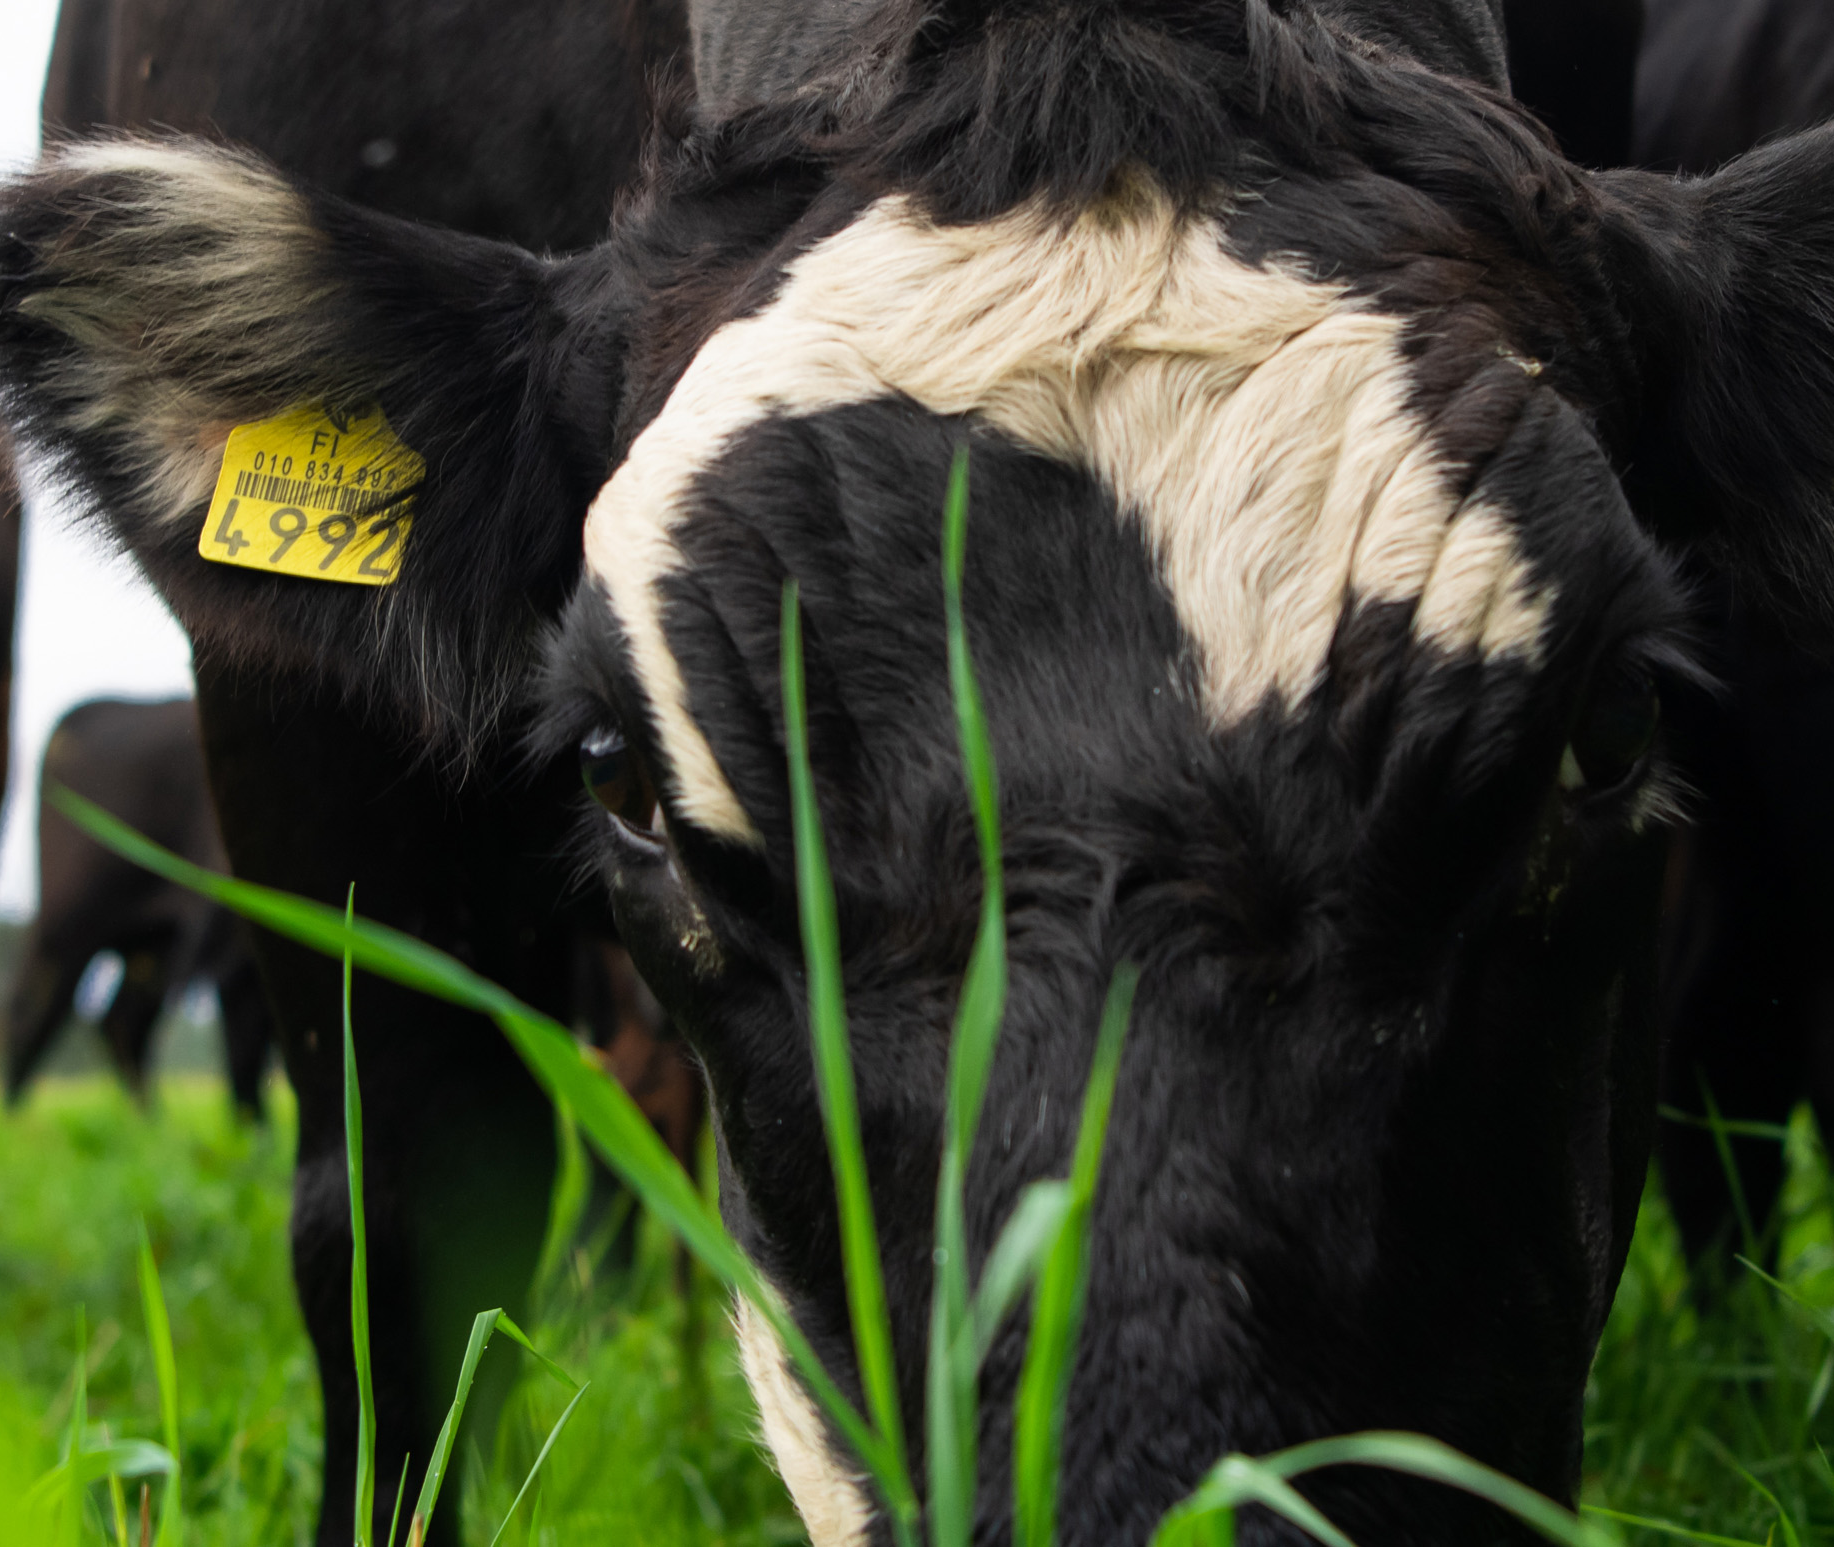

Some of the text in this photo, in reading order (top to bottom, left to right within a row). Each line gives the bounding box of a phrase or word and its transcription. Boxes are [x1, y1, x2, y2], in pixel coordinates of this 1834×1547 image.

[310, 431, 340, 458] FI
[254, 451, 293, 475] 010
[304, 460, 344, 484] 834
[214, 498, 400, 577] 4992
